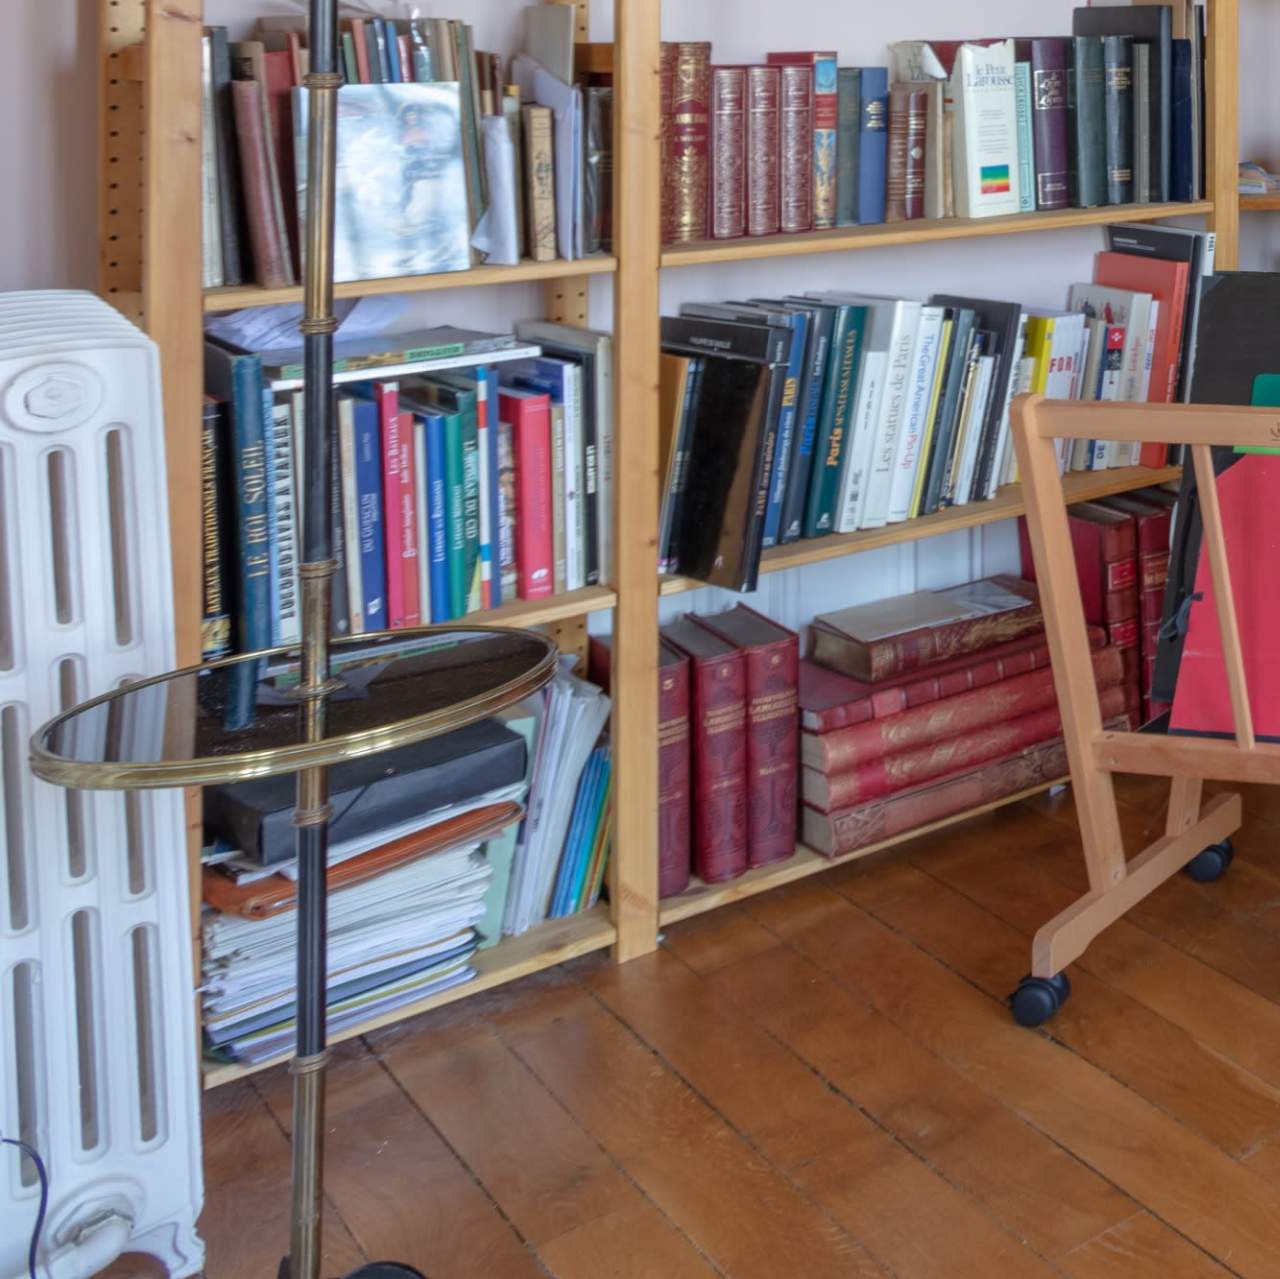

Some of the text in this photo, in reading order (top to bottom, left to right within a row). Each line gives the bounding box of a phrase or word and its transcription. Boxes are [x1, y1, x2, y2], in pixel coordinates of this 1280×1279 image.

[967, 74, 1013, 87] Larousse
[985, 64, 1005, 76] Petit
[781, 377, 797, 407] PARIS
[876, 333, 912, 474] Les statues de Paris
[388, 417, 399, 474] LES BATEAUX
[825, 427, 843, 467] Paris
[901, 433, 919, 470] Pin-Up
[244, 440, 268, 578] LE ROI SOLEIL
[361, 494, 373, 552] DU GUESCLIN
[207, 565, 221, 613] BATEAUX
